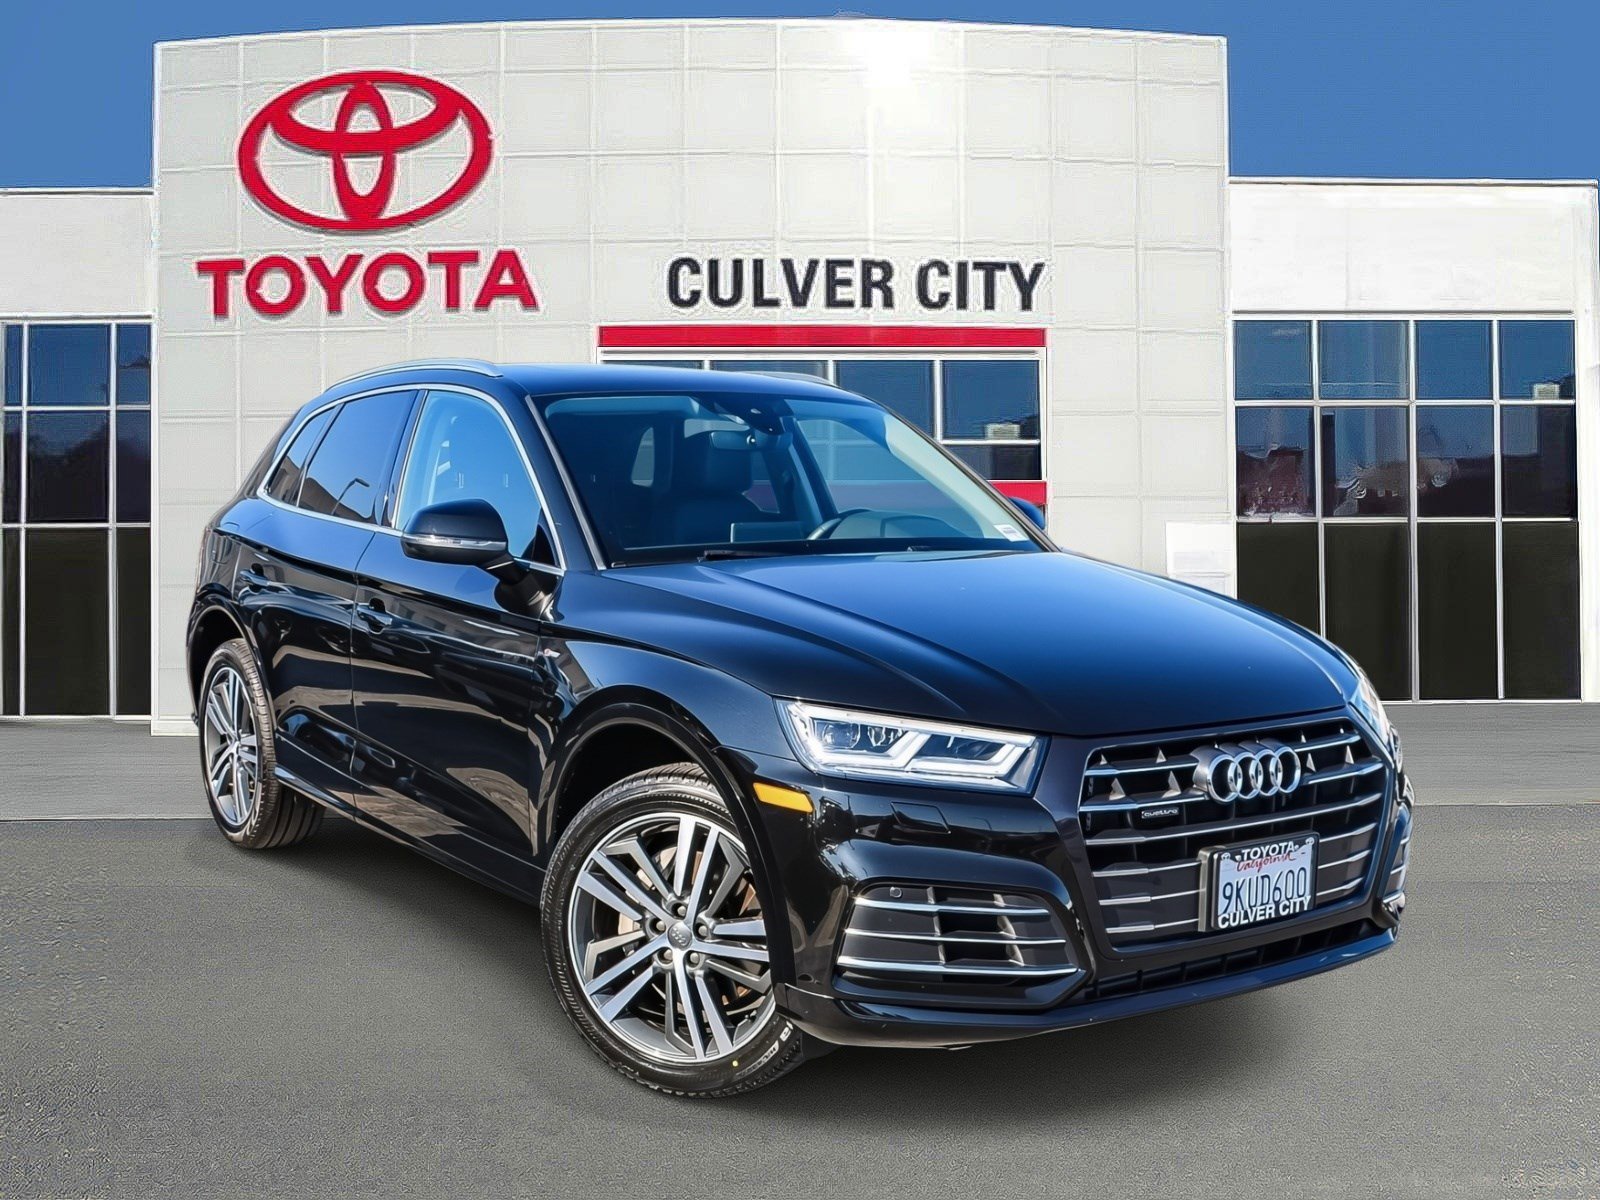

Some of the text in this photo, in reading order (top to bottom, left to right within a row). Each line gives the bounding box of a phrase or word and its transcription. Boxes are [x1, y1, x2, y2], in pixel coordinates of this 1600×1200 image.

[195, 249, 540, 319] TOYOTA
[667, 257, 1046, 311] CULVER CITY
[1241, 841, 1296, 861] TOYOTA
[1217, 895, 1312, 929] CULVER CITY
[1222, 867, 1307, 914] 9KUD600
